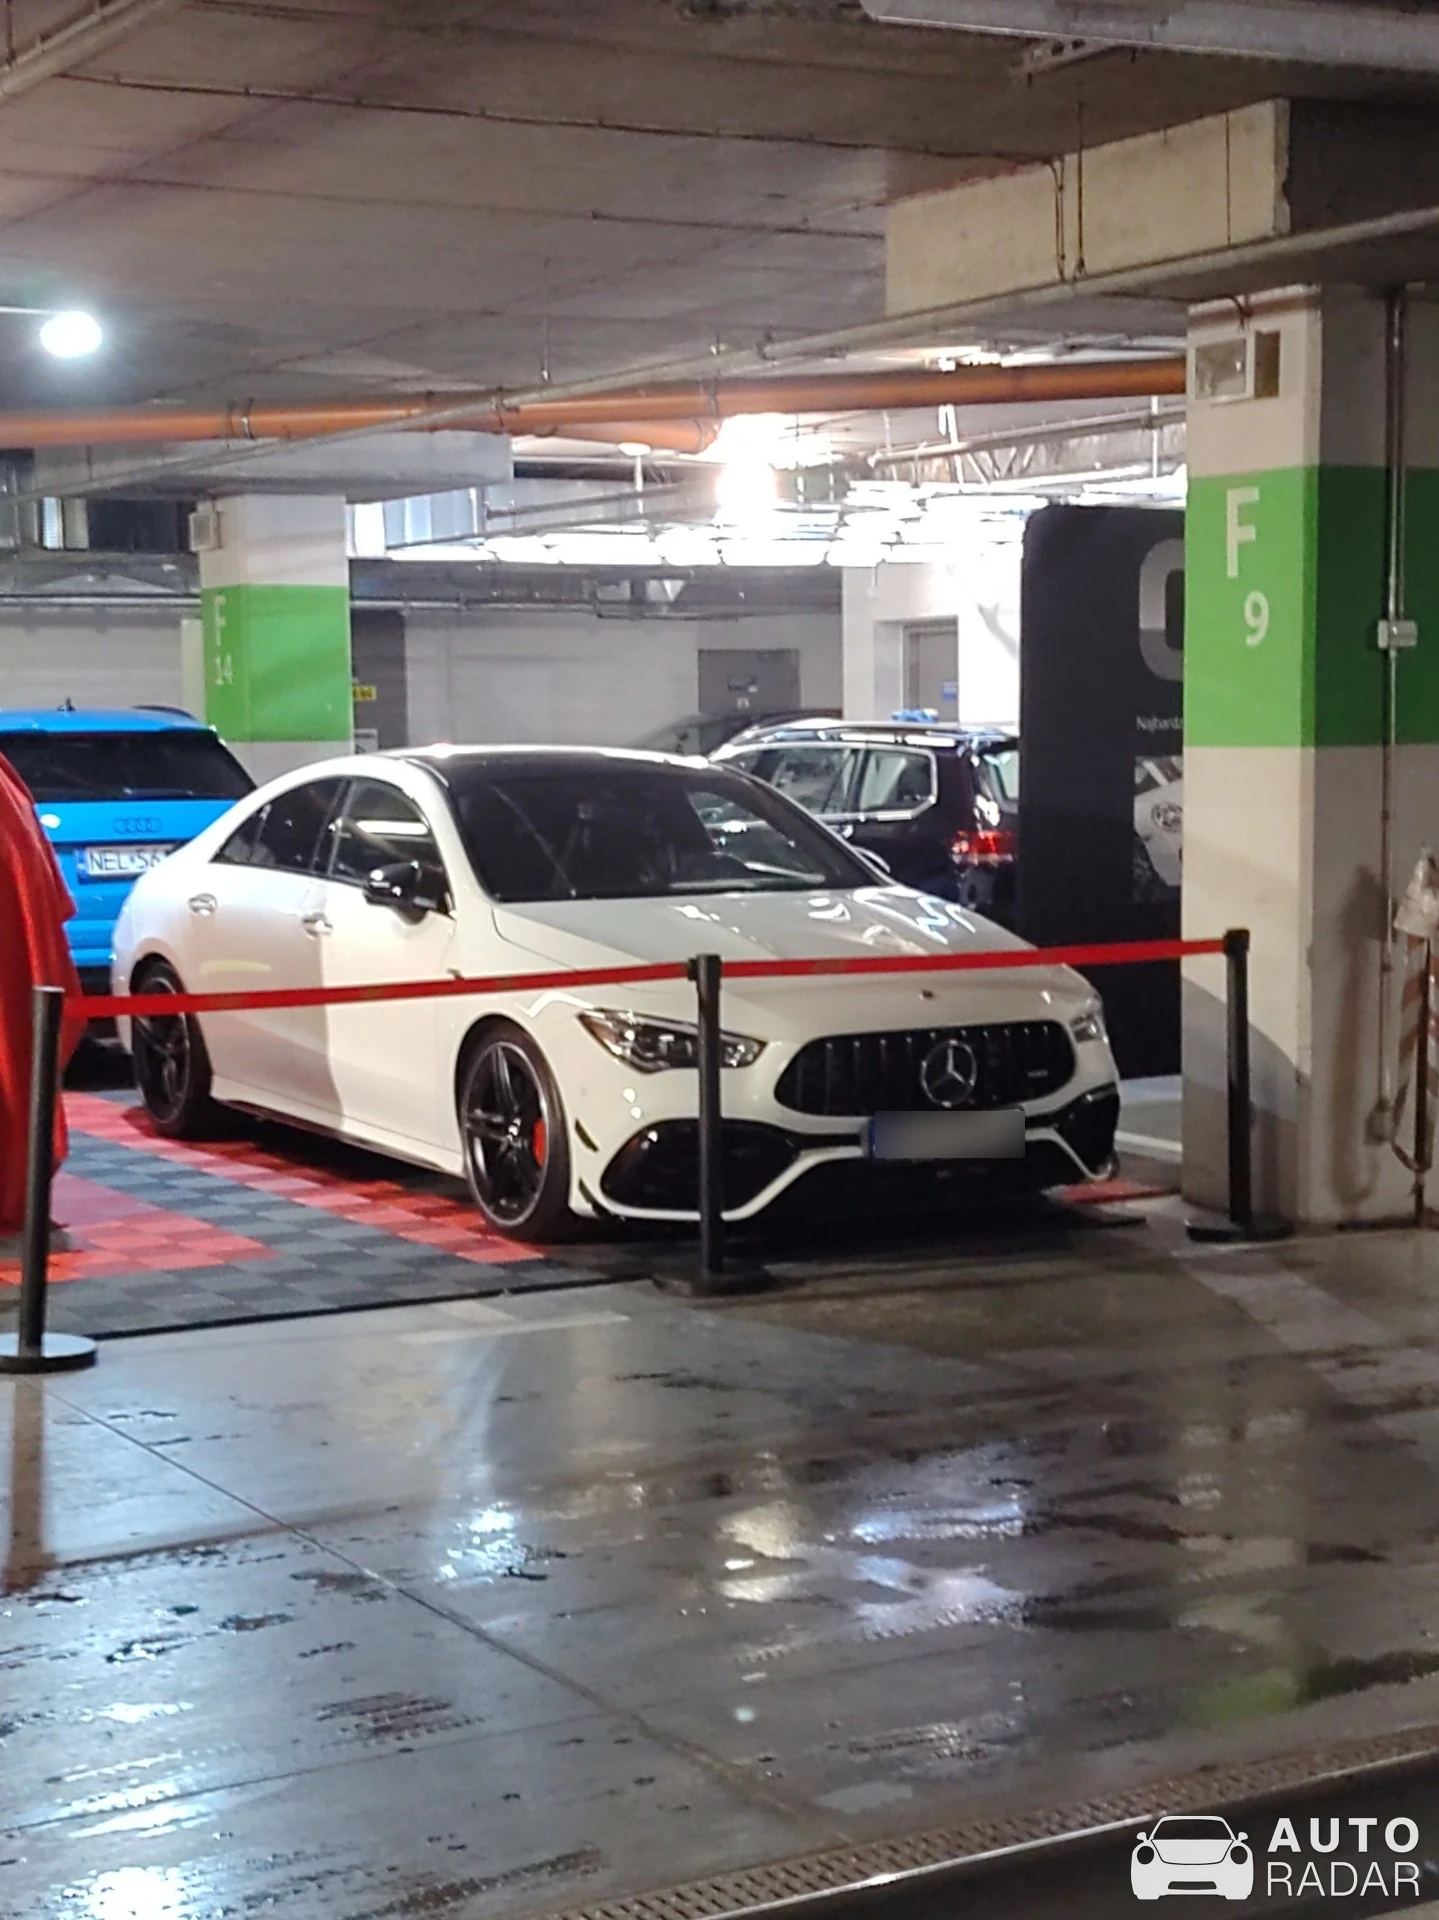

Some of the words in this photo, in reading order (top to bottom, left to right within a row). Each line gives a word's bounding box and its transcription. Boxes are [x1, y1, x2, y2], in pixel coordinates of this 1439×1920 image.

[1226, 486, 1260, 579] F
[213, 594, 227, 647] F
[1244, 590, 1270, 647] 9
[215, 653, 233, 685] 14
[89, 850, 129, 872] NEL
